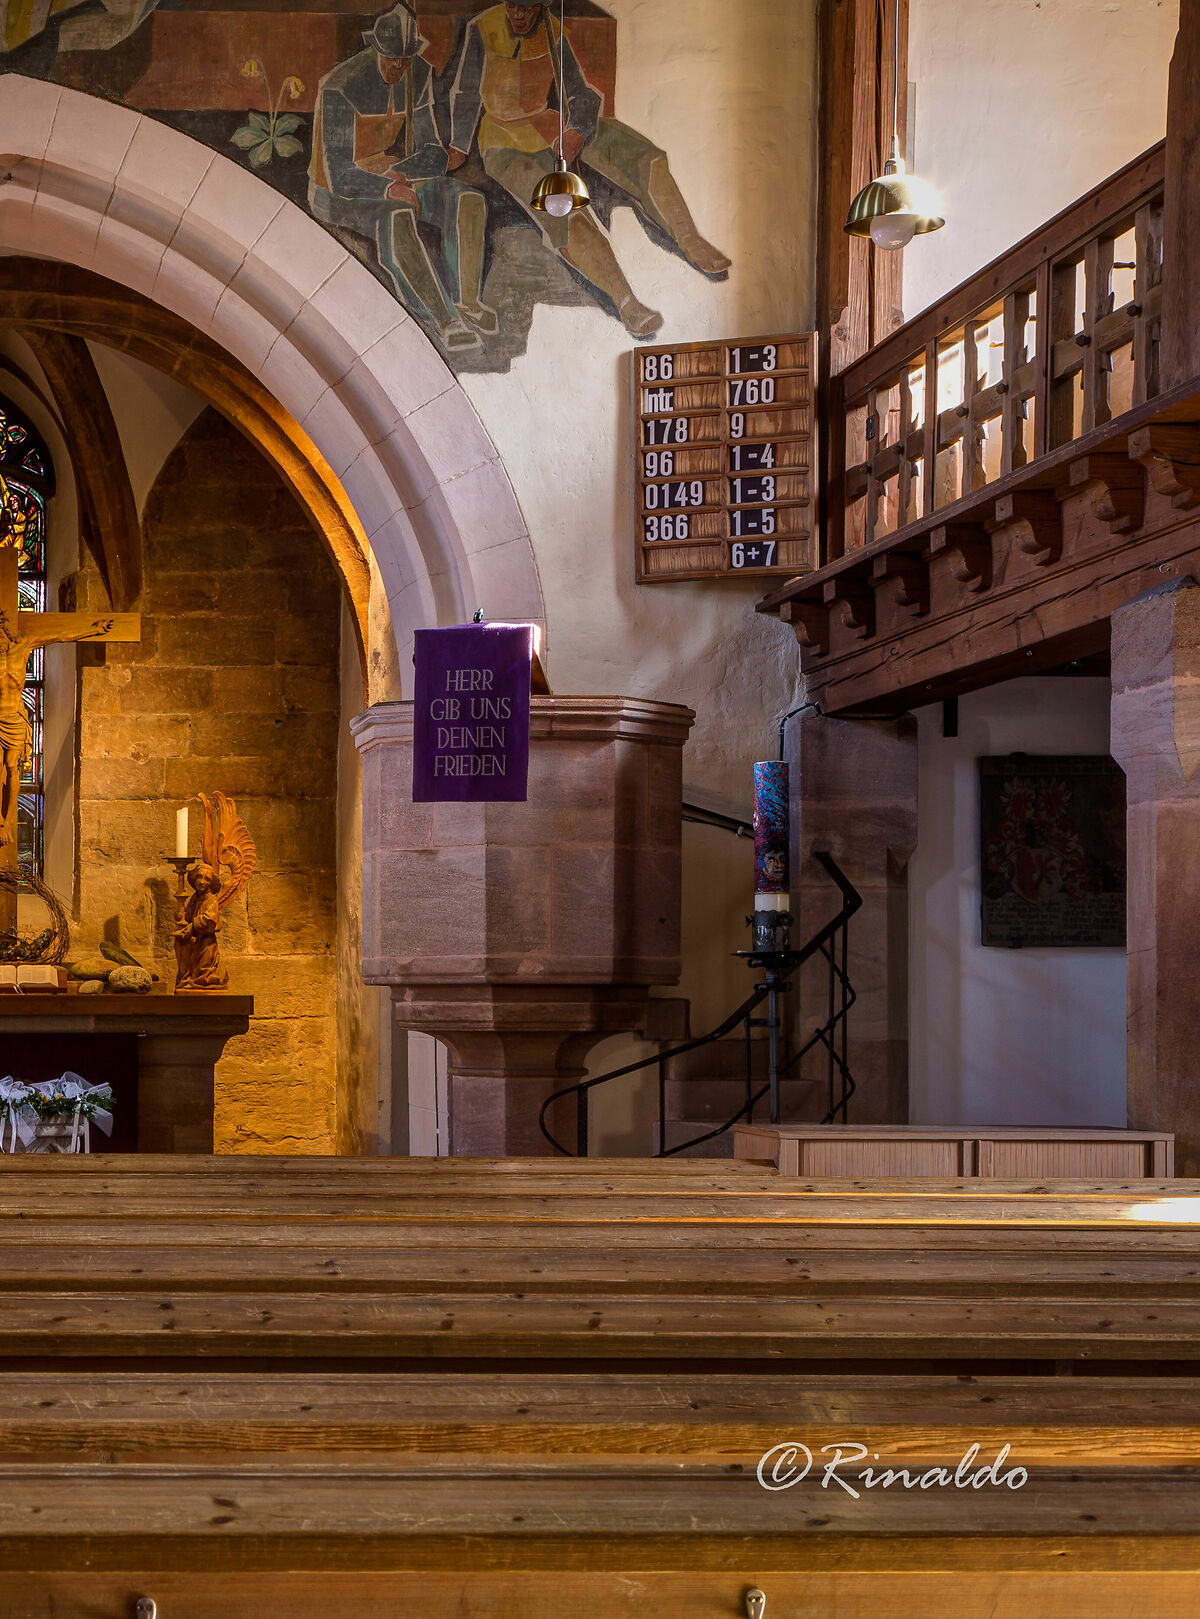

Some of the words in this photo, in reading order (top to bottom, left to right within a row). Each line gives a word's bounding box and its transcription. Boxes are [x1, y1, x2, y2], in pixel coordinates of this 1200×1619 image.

[644, 354, 673, 381] 86
[731, 377, 775, 406] 760
[646, 417, 688, 445] 178
[730, 413, 744, 439] 9
[645, 451, 674, 478] 96
[645, 480, 704, 510] 0149
[645, 514, 689, 542] 366
[445, 669, 494, 692] HERR
[430, 698, 461, 721] GIB
[470, 697, 512, 720] UNS
[437, 726, 505, 749] DEINEN
[433, 754, 507, 777] FRIEDEN
